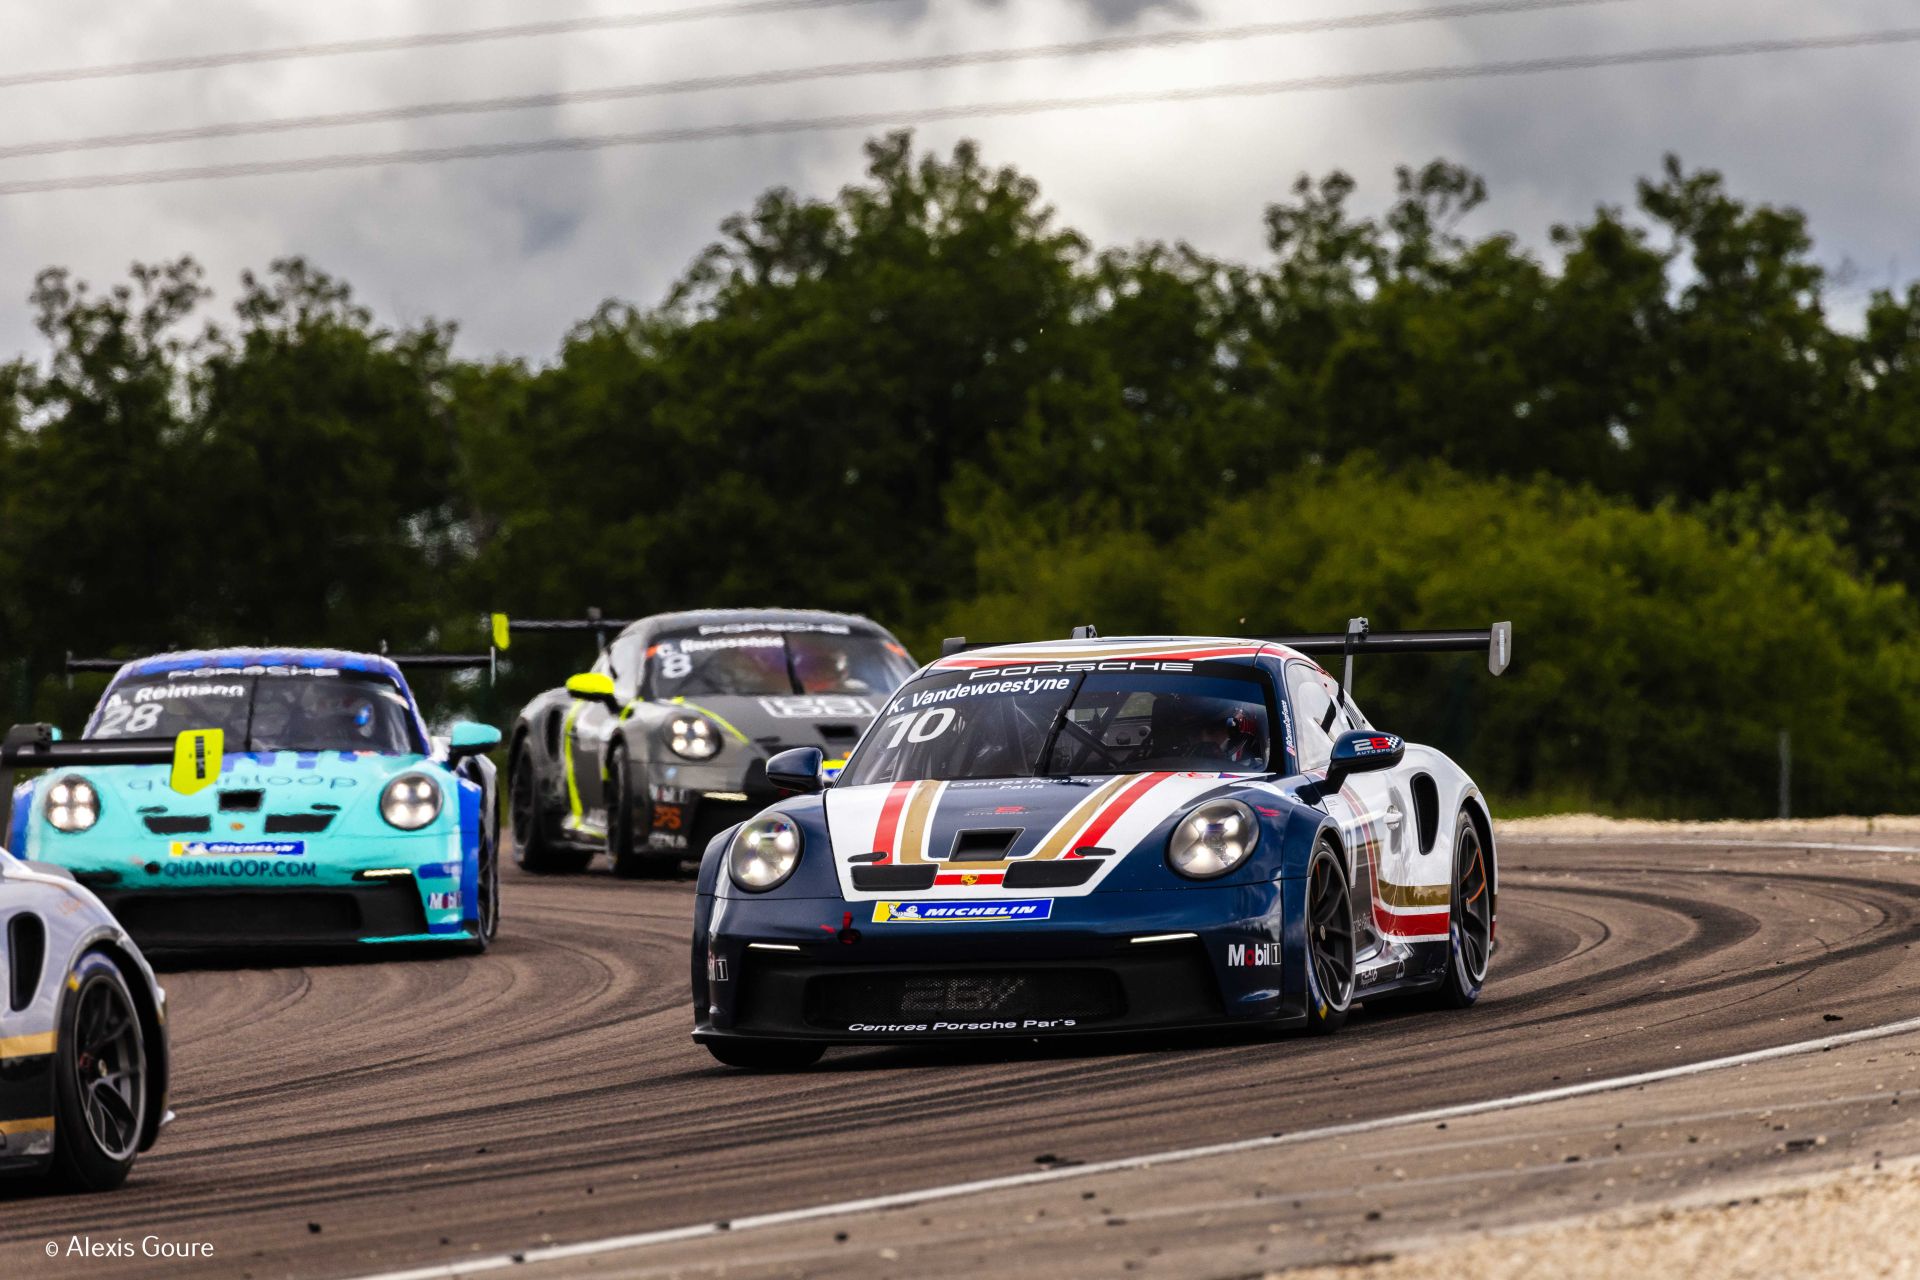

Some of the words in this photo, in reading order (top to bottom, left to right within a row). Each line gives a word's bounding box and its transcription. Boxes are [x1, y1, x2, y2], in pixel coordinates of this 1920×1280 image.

[662, 653, 692, 678] 8
[968, 661, 1193, 681] PORSCHE
[887, 697, 906, 716] K.
[912, 677, 1070, 708] Vandewoestyne
[93, 703, 164, 738] 28
[887, 707, 956, 750] 10
[128, 775, 357, 792] qnloop
[950, 780, 1023, 788] Centres
[163, 859, 317, 878] QUANLOOP.COM
[924, 905, 1038, 917] MICHELIN
[1228, 943, 1270, 968] Mobil
[848, 1022, 928, 1032] Centres
[932, 1020, 1017, 1031] Porsche
